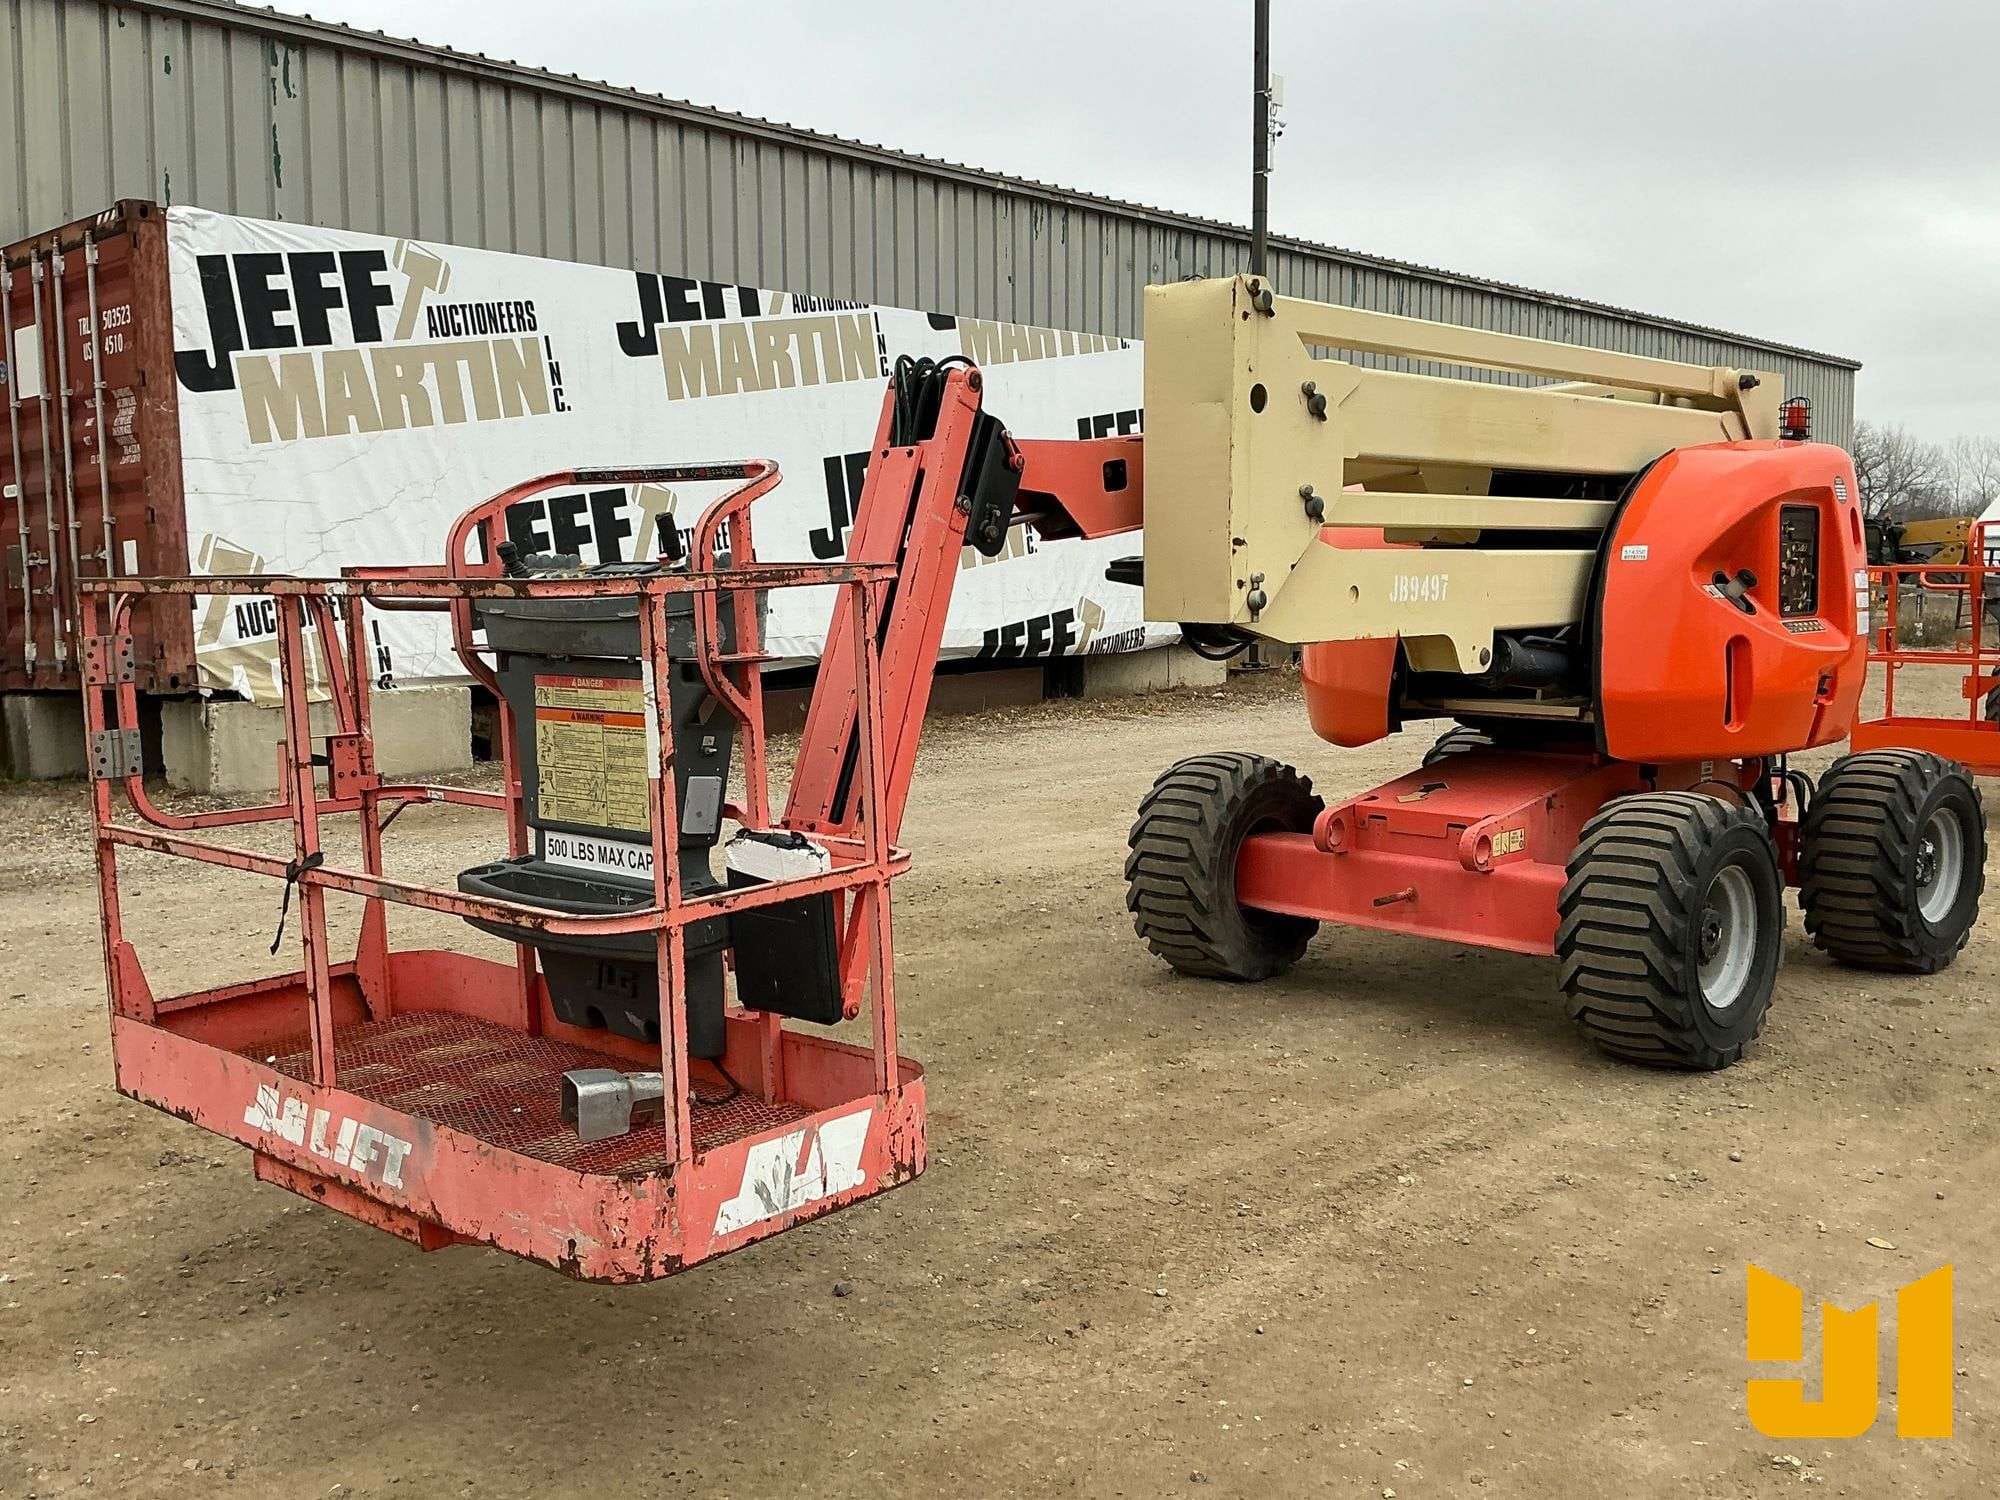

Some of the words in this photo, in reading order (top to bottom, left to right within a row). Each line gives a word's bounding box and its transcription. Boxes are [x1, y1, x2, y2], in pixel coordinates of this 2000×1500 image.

[103, 304, 130, 330] 503523
[105, 333, 123, 355] 4510
[175, 250, 394, 393] JEFF
[427, 300, 538, 338] AUCTIONEERS
[873, 311, 893, 378] INC.
[235, 337, 551, 444] MARTIN
[544, 335, 572, 413] INC.
[658, 313, 878, 401] MARTIN
[477, 488, 632, 564] EFF
[1389, 573, 1448, 602] JB9497
[548, 838, 568, 858] 500
[571, 841, 595, 862] LBS
[598, 845, 625, 868] MAX
